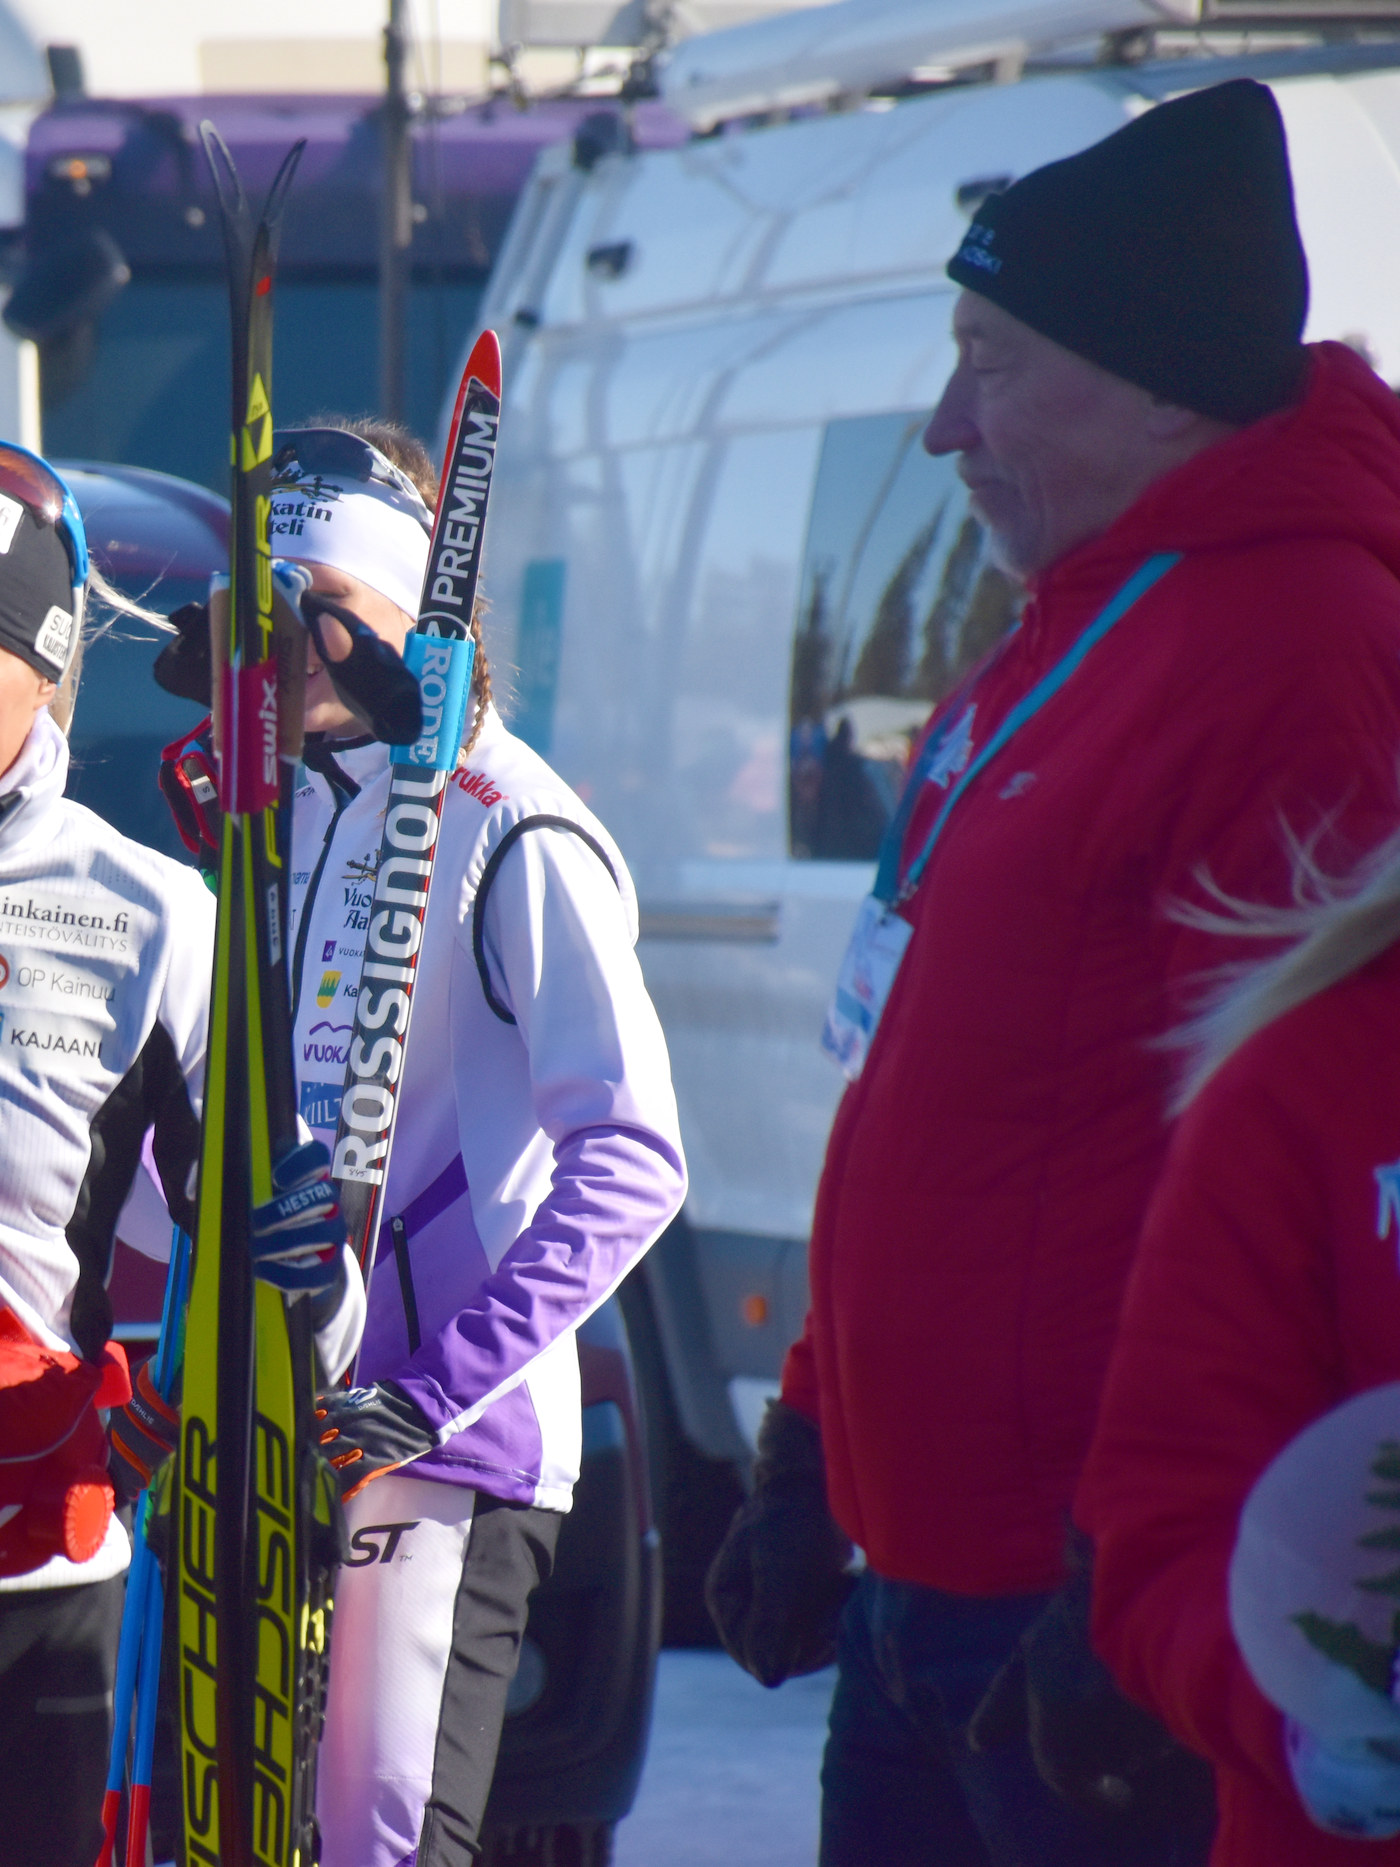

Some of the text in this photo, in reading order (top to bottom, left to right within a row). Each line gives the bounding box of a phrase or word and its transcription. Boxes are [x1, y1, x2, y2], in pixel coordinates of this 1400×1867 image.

[271, 500, 333, 523] katin
[271, 518, 305, 537] teli
[431, 411, 499, 606] PREMIUM
[408, 645, 454, 765] RODE
[258, 677, 279, 788] swix
[450, 766, 503, 809] rukka
[17, 966, 117, 1002] OP Kainuu
[331, 766, 448, 1187] ROSSIGNOL
[10, 1028, 104, 1060] KAJAANI
[277, 1181, 335, 1217] HESTRA
[341, 1521, 421, 1568] ST
[183, 1416, 219, 1867] ISCHER
